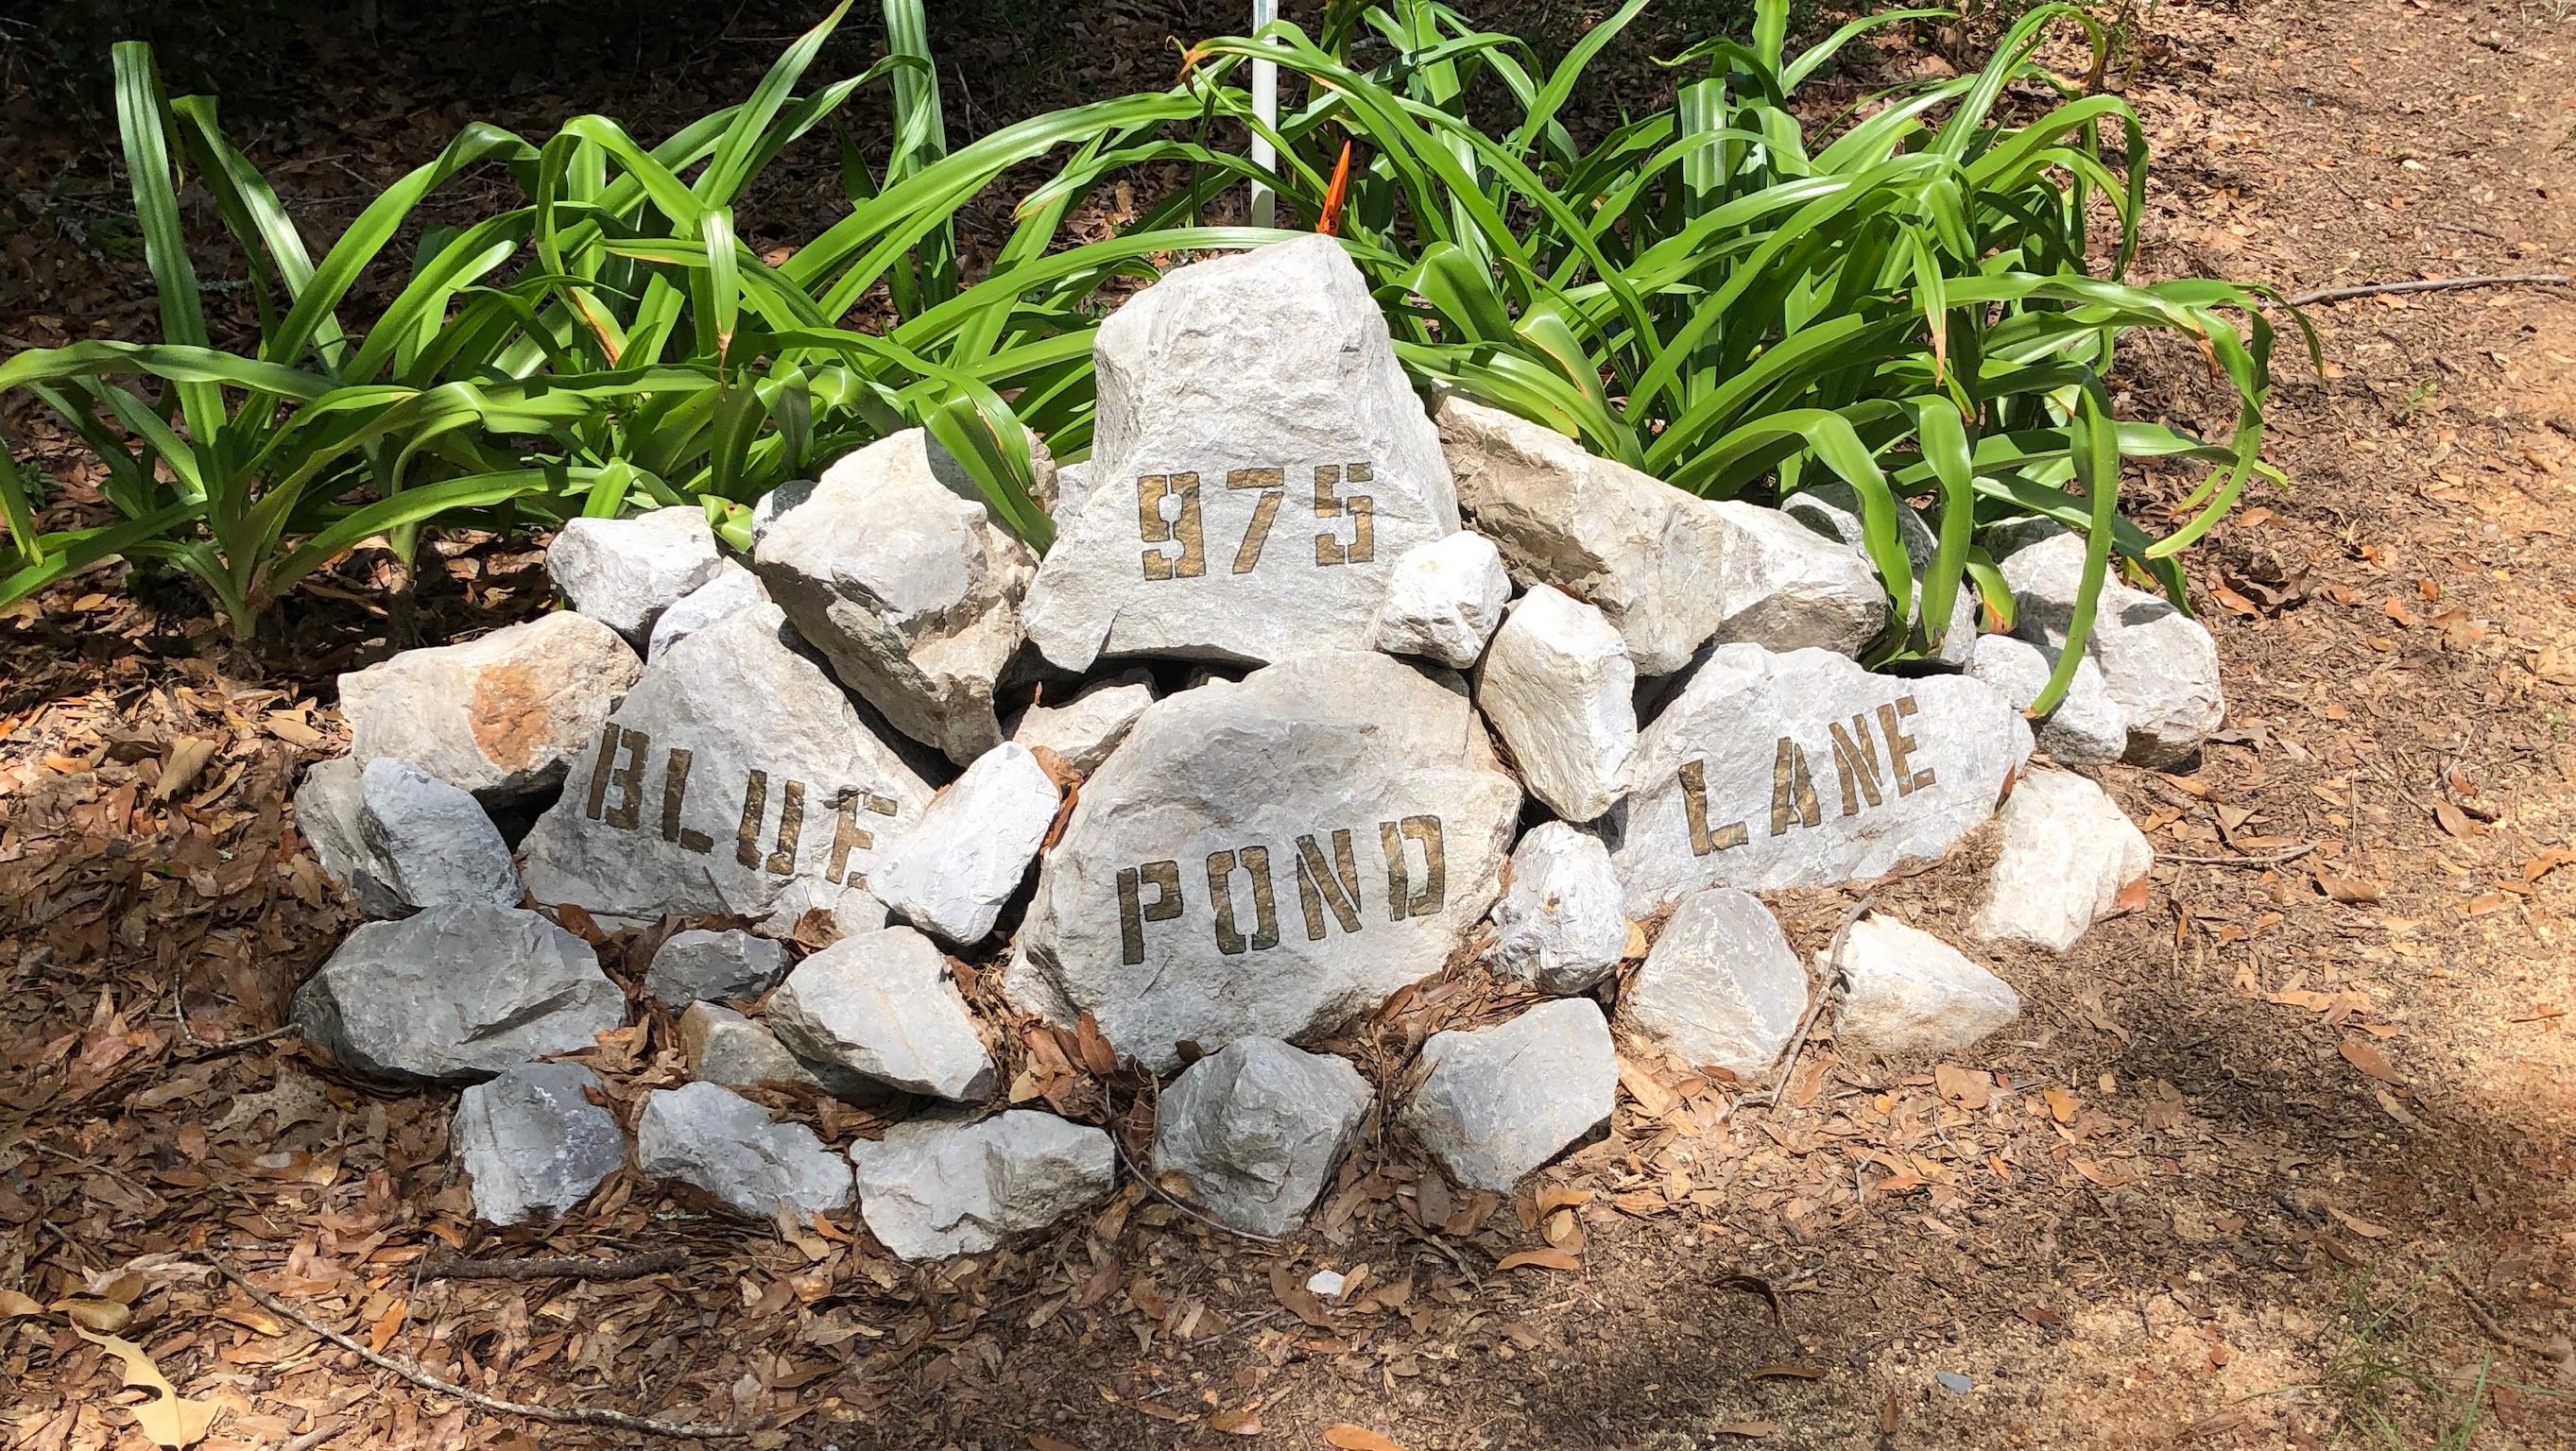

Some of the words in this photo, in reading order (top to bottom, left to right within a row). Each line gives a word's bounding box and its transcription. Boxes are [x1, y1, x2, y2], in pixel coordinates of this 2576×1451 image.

[1137, 462, 1375, 581] 975
[586, 721, 898, 891] BLUE
[1678, 694, 1936, 857] LANE
[1117, 814, 1446, 965] POND
